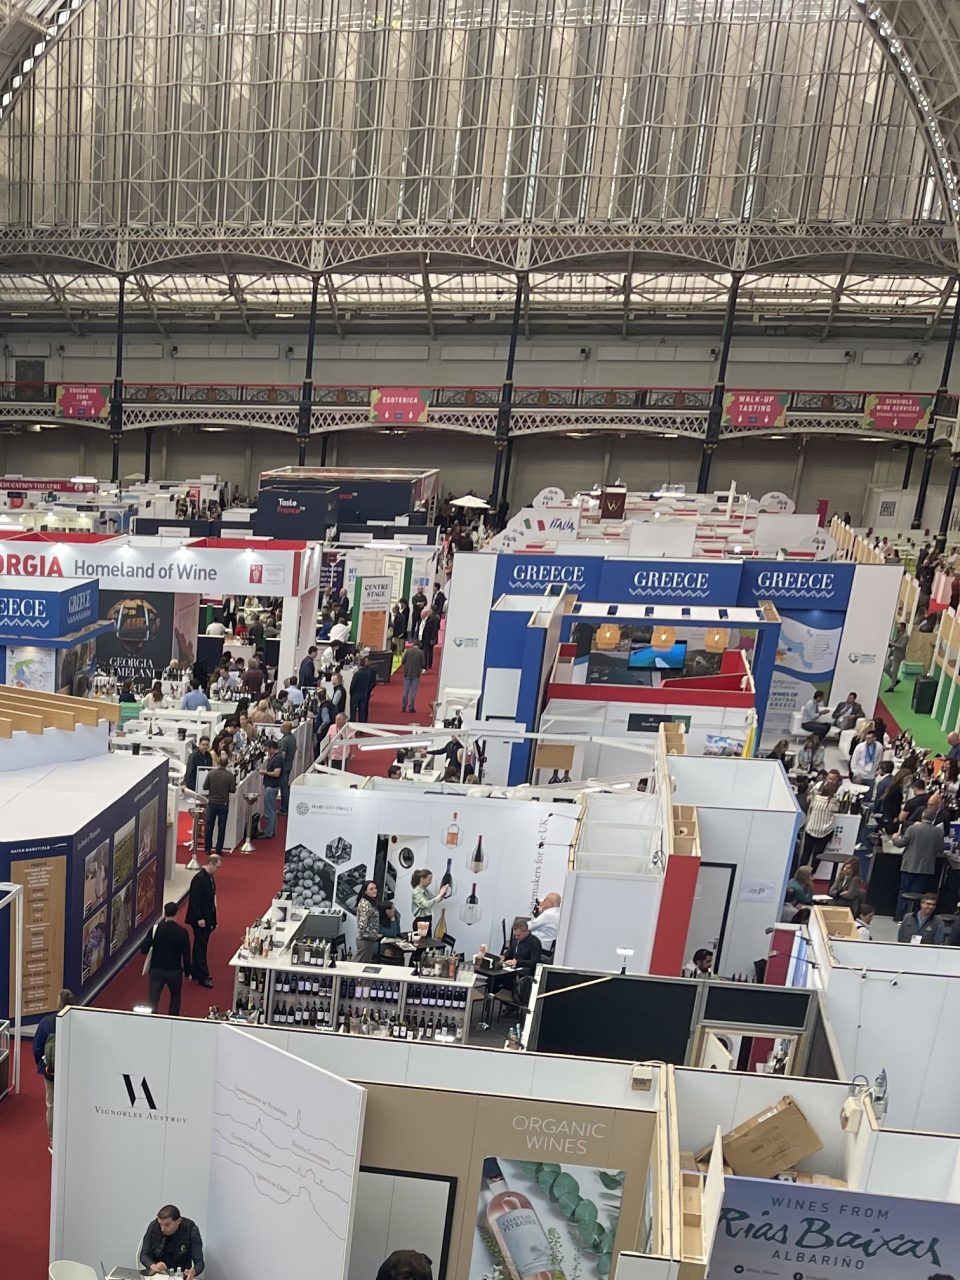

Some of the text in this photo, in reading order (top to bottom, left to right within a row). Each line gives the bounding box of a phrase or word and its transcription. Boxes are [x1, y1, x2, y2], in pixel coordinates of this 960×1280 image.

[68, 387, 97, 395] EDUCATION
[382, 396, 418, 404] ESOTERICA
[739, 395, 775, 403] WALK-UP
[739, 404, 771, 413] TASTING
[0, 482, 31, 490] EDUCATION
[74, 559, 155, 580] Homeland
[158, 560, 174, 580] of
[176, 563, 218, 581] Wine
[513, 563, 585, 583] GREECE
[364, 583, 388, 591] CENTRE
[634, 570, 710, 590] GREECE
[757, 571, 835, 590] GREECE
[366, 590, 386, 598] STAGE
[109, 656, 154, 668] GEORGIA
[512, 1115, 607, 1139] ORGANIC
[526, 1135, 587, 1155] WINES
[771, 1196, 890, 1220] WINES FROM
[795, 1217, 942, 1267] Baixas
[772, 1250, 866, 1270] ALBARIÑO
